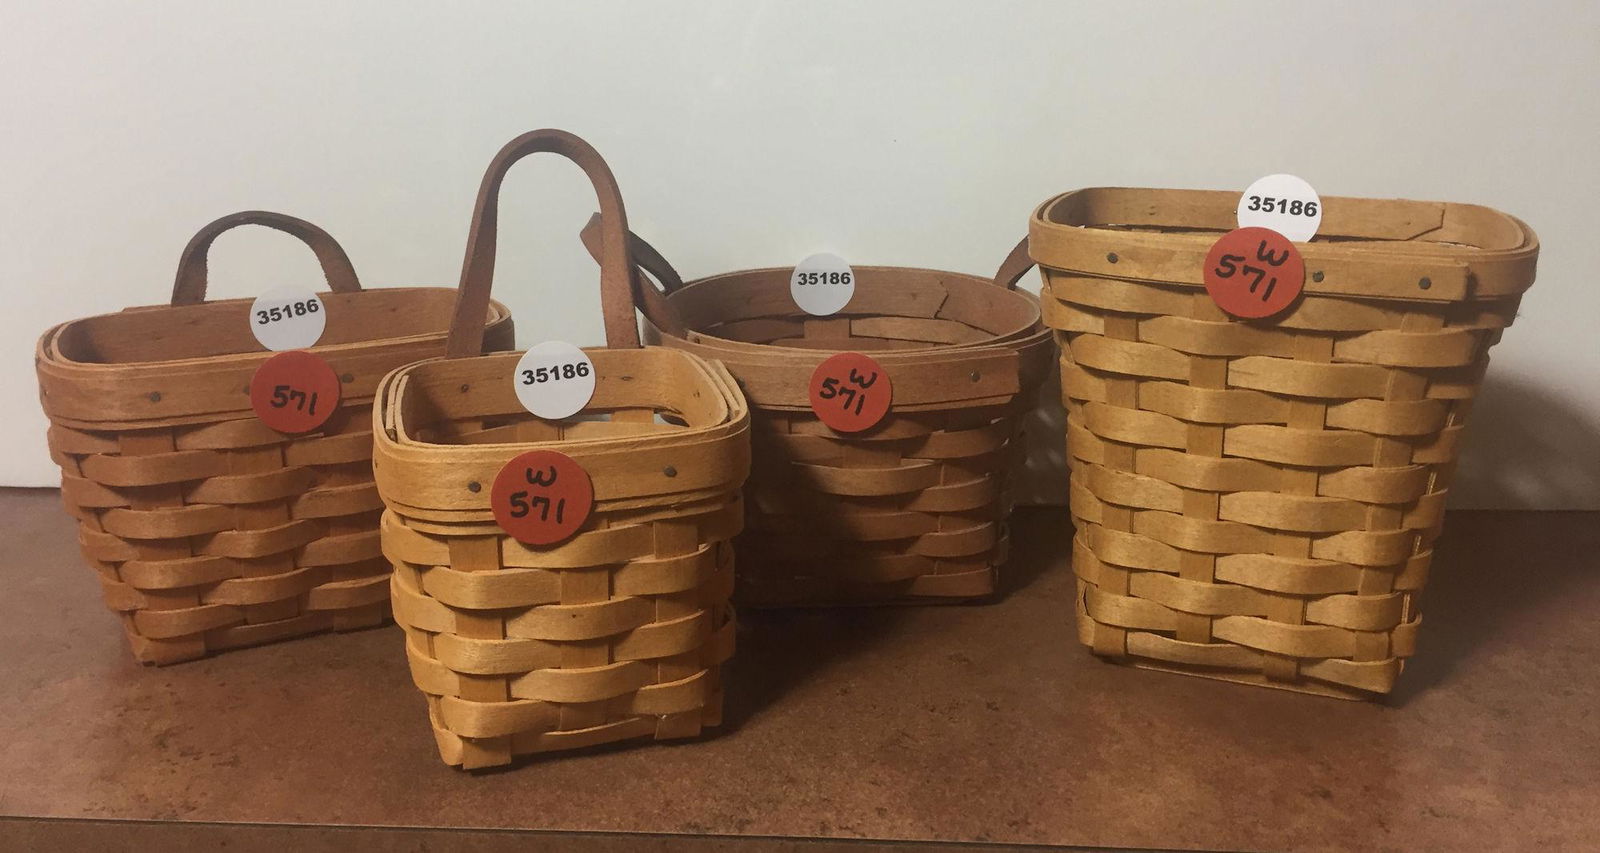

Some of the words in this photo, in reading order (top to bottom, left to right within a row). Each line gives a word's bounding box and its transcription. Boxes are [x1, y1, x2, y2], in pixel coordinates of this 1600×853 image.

[1247, 195, 1318, 218] 35186
[797, 271, 852, 286] 35186
[1214, 253, 1278, 303] 571
[256, 298, 320, 325] 35186
[521, 361, 590, 386] 35186
[269, 384, 318, 417] 571
[819, 377, 866, 417] 571
[509, 490, 567, 525] 571
